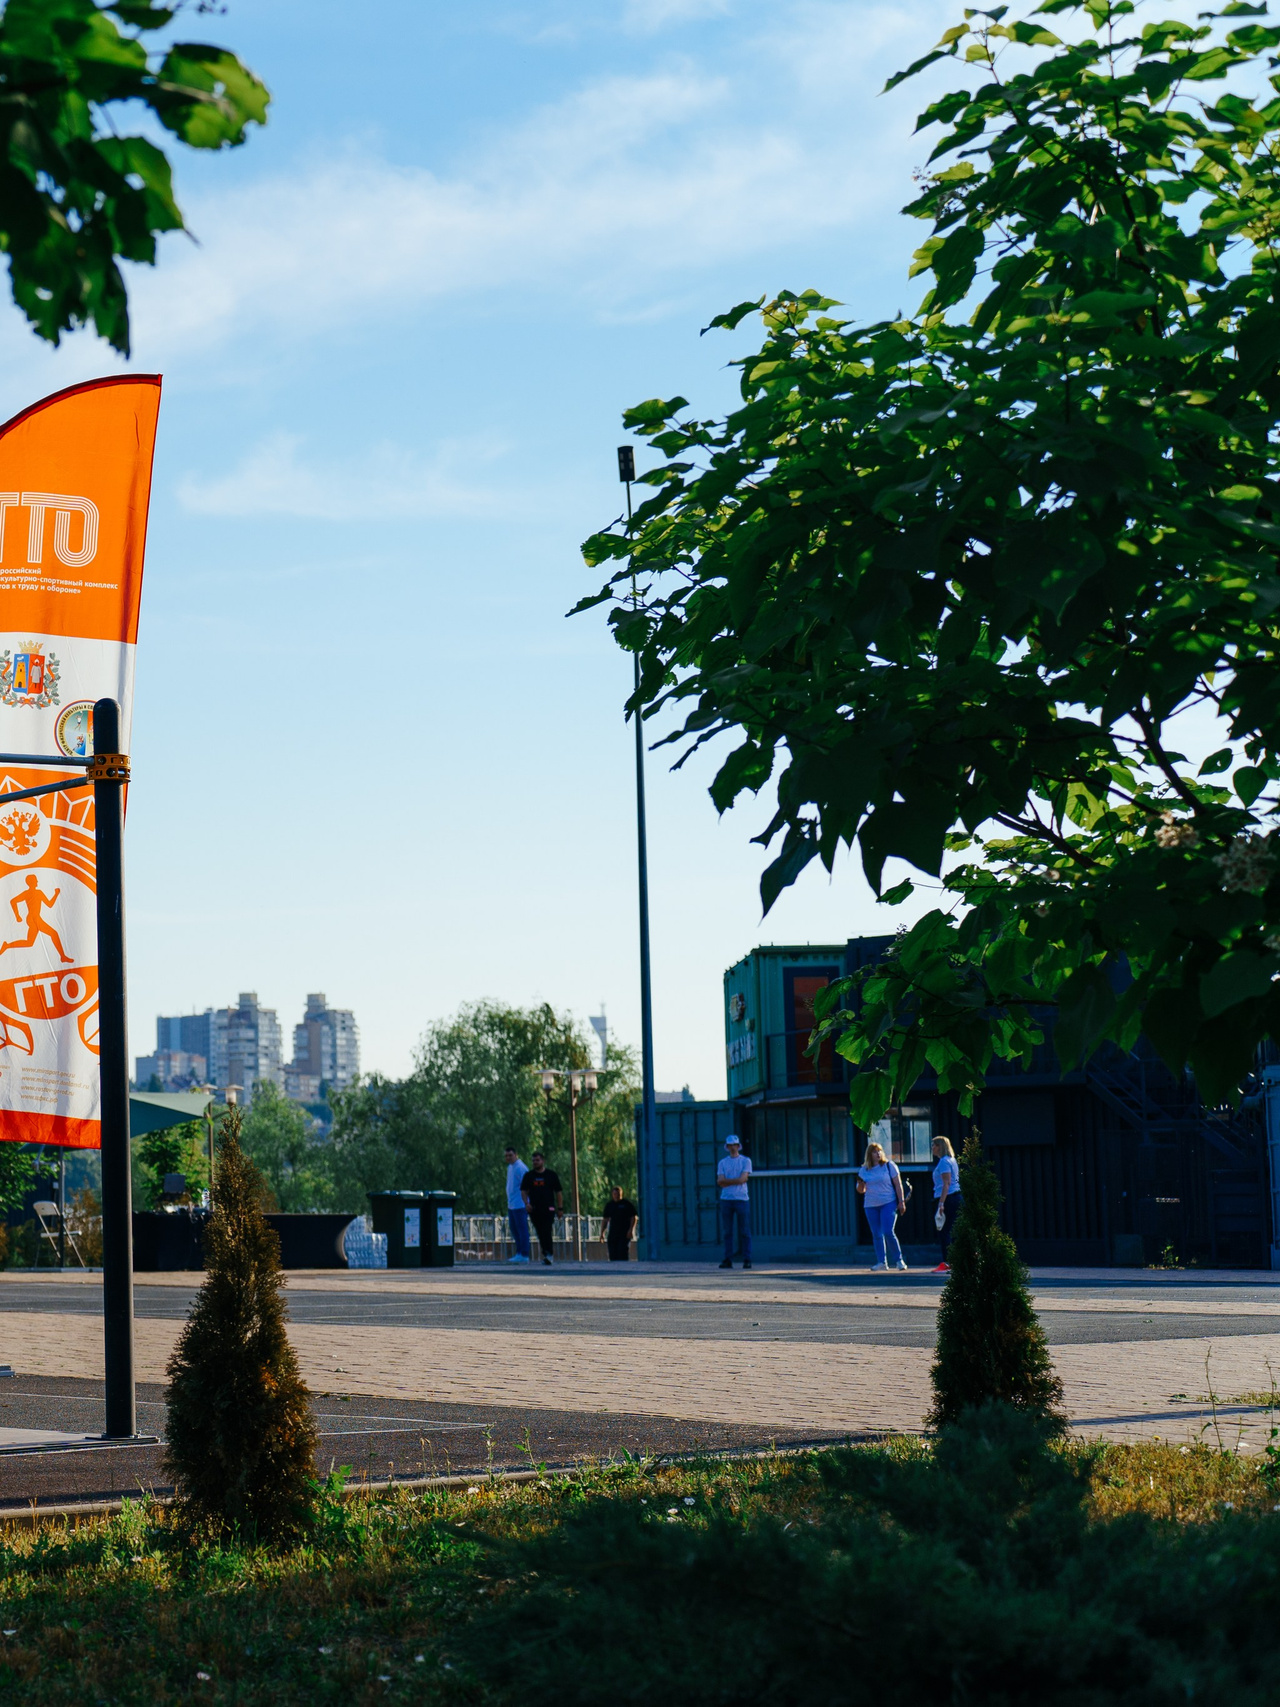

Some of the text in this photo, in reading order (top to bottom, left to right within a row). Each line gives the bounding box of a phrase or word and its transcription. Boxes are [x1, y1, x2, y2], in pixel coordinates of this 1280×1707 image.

[17, 583, 39, 592] труду
[46, 584, 81, 594] обороне»
[84, 581, 119, 590] комплекс
[14, 972, 87, 1014] ГТО
